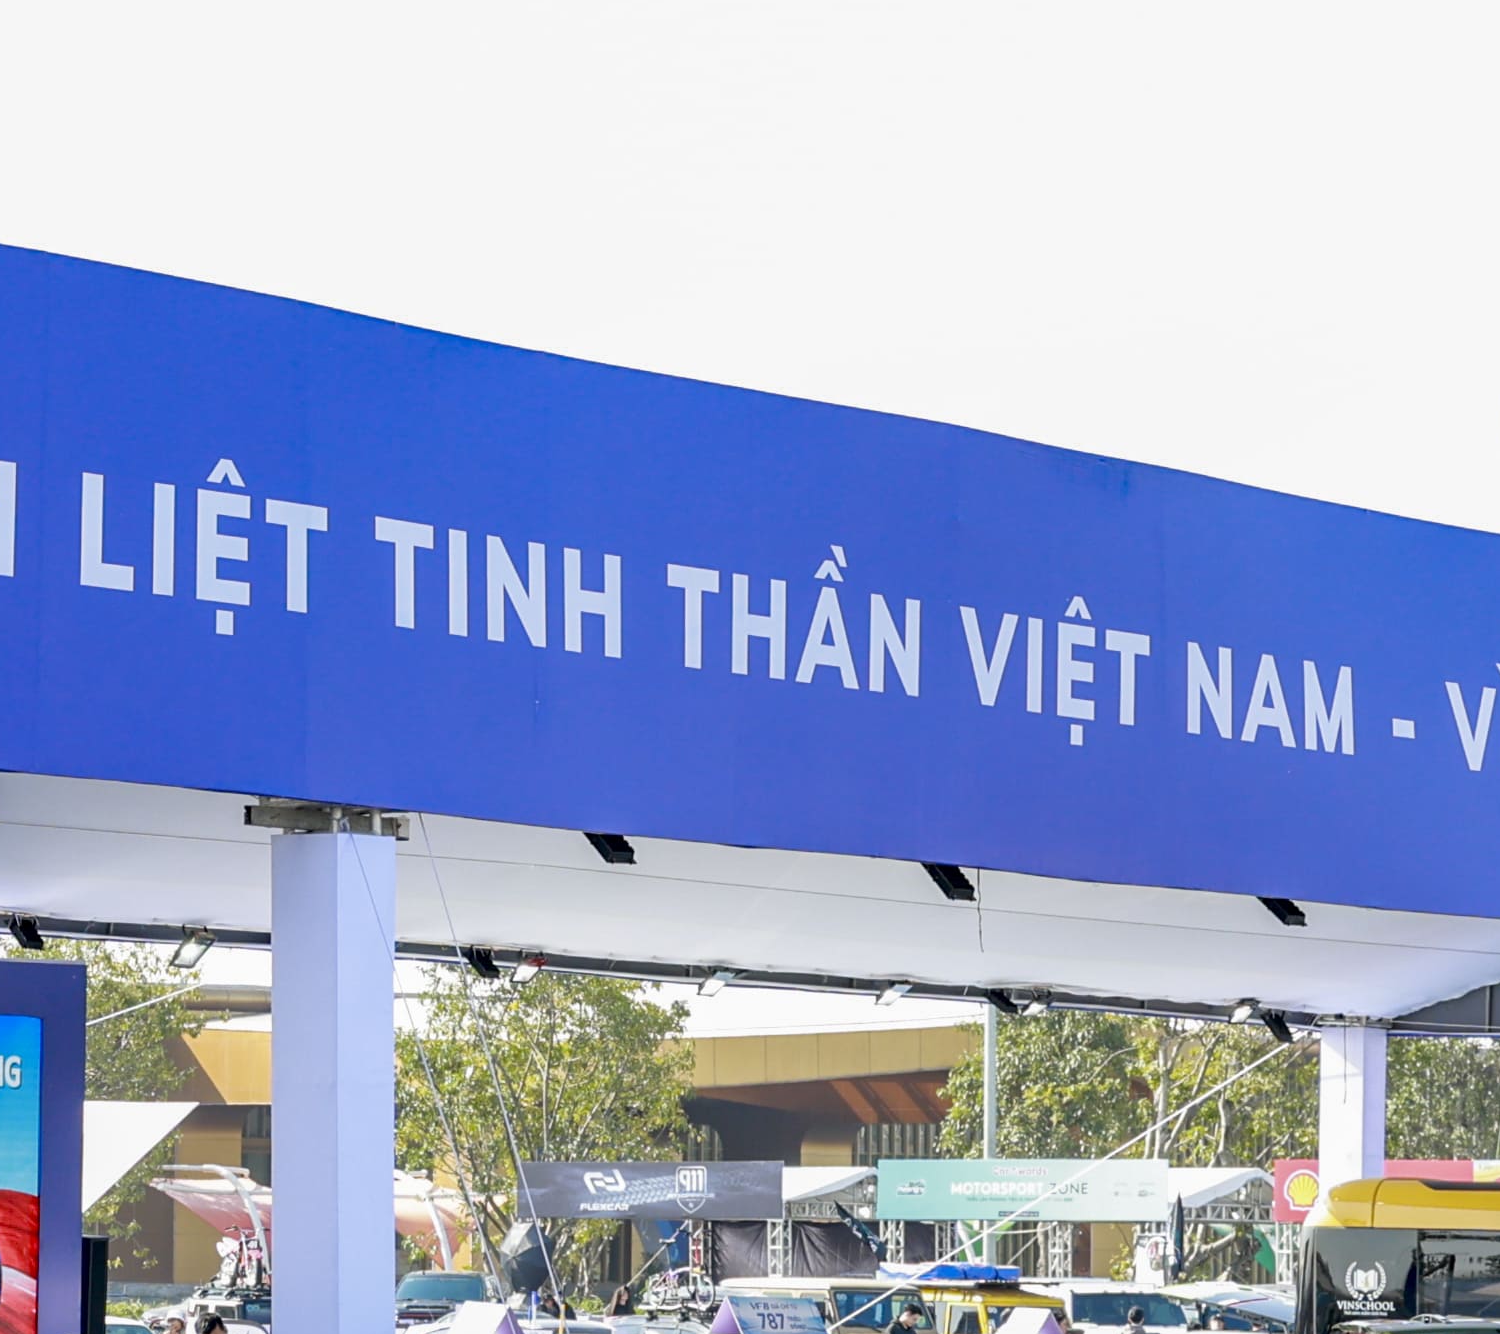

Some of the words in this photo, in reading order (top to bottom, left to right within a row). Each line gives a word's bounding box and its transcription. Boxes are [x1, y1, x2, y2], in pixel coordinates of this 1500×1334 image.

[80, 458, 329, 636] LIỆT
[374, 516, 622, 659] TINH
[667, 544, 921, 698] THẦN
[959, 596, 1151, 747] VIỆT
[1187, 641, 1355, 756] NAM
[1392, 718, 1416, 740] -
[680, 1169, 704, 1192] 911
[950, 1182, 1044, 1196] MOTORSPORT
[1336, 1300, 1396, 1312] VINSCHOOL
[757, 1313, 785, 1329] 787
